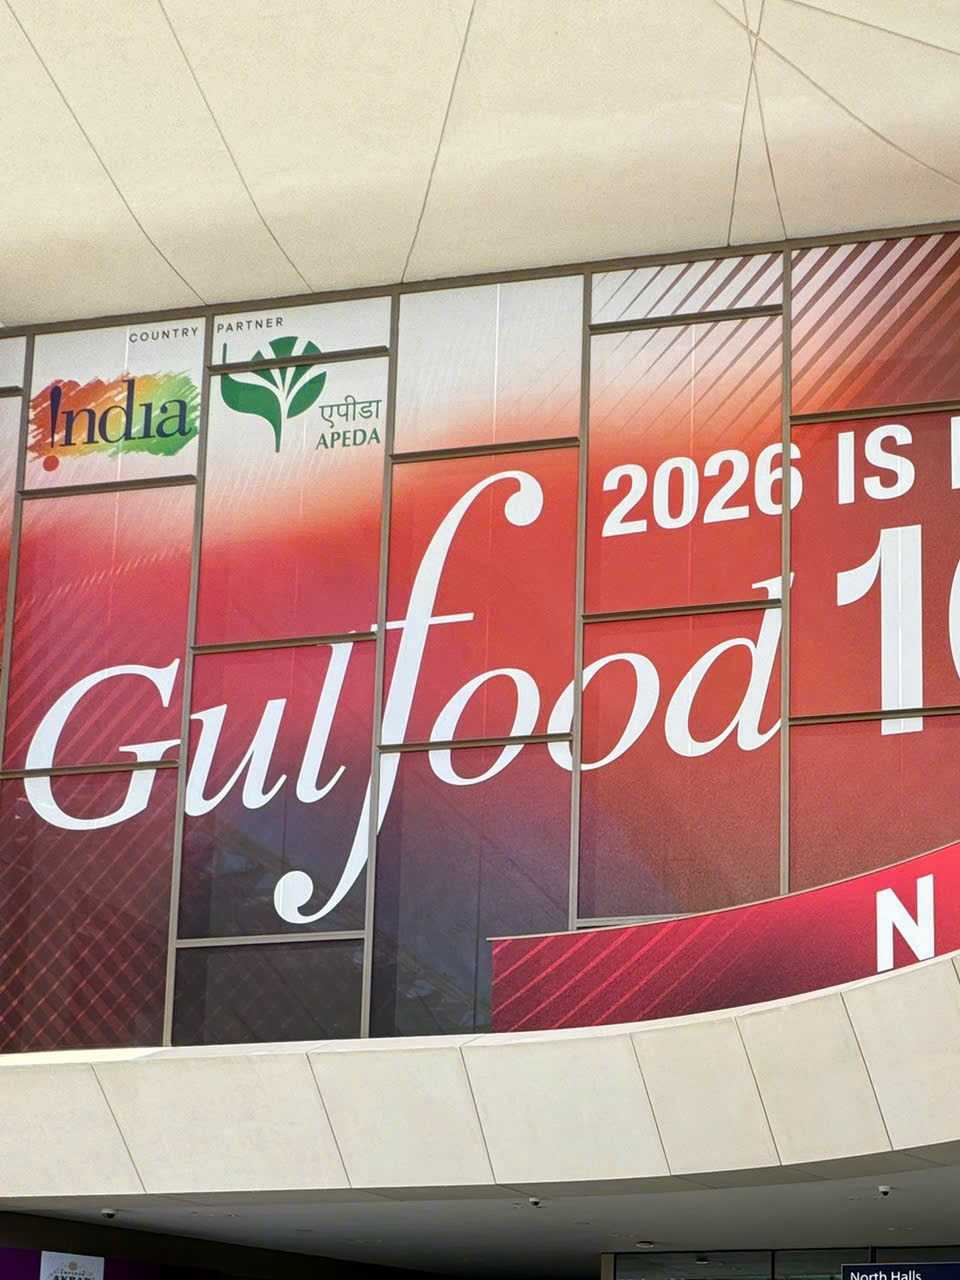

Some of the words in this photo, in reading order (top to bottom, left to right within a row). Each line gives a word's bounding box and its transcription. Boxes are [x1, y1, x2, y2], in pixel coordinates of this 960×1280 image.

[129, 326, 199, 343] COUNTRY
[216, 317, 284, 334] PARTNER
[318, 395, 383, 429] एपीडा
[315, 427, 382, 450] APEDA
[602, 441, 804, 538] 2026
[837, 424, 916, 505] IS
[23, 470, 796, 924] Gulfood
